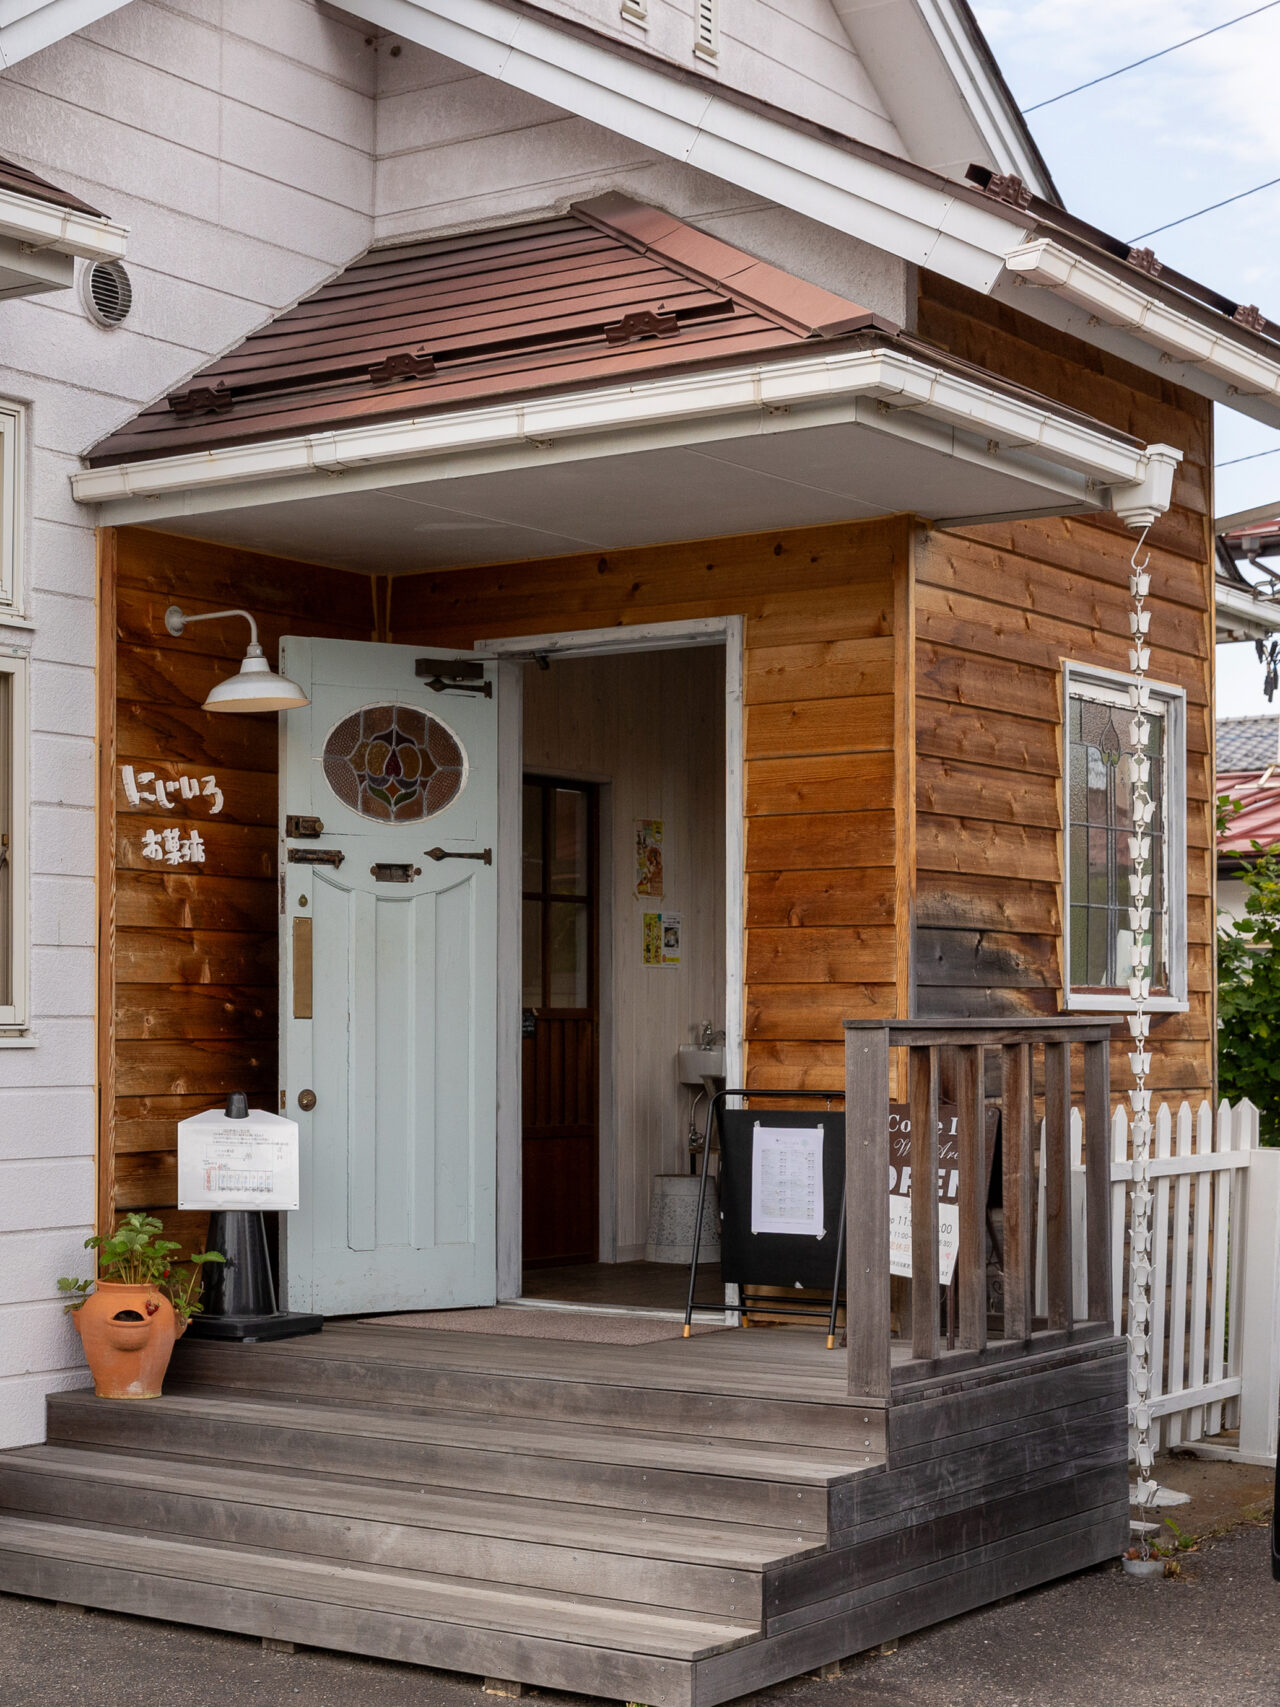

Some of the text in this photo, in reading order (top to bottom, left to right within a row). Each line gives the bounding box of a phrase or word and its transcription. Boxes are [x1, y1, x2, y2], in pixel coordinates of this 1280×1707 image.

[121, 765, 224, 815] にじいろ
[141, 827, 206, 865] お菓子店
[889, 1114, 959, 1136] Coe I
[893, 1138, 912, 1157] W
